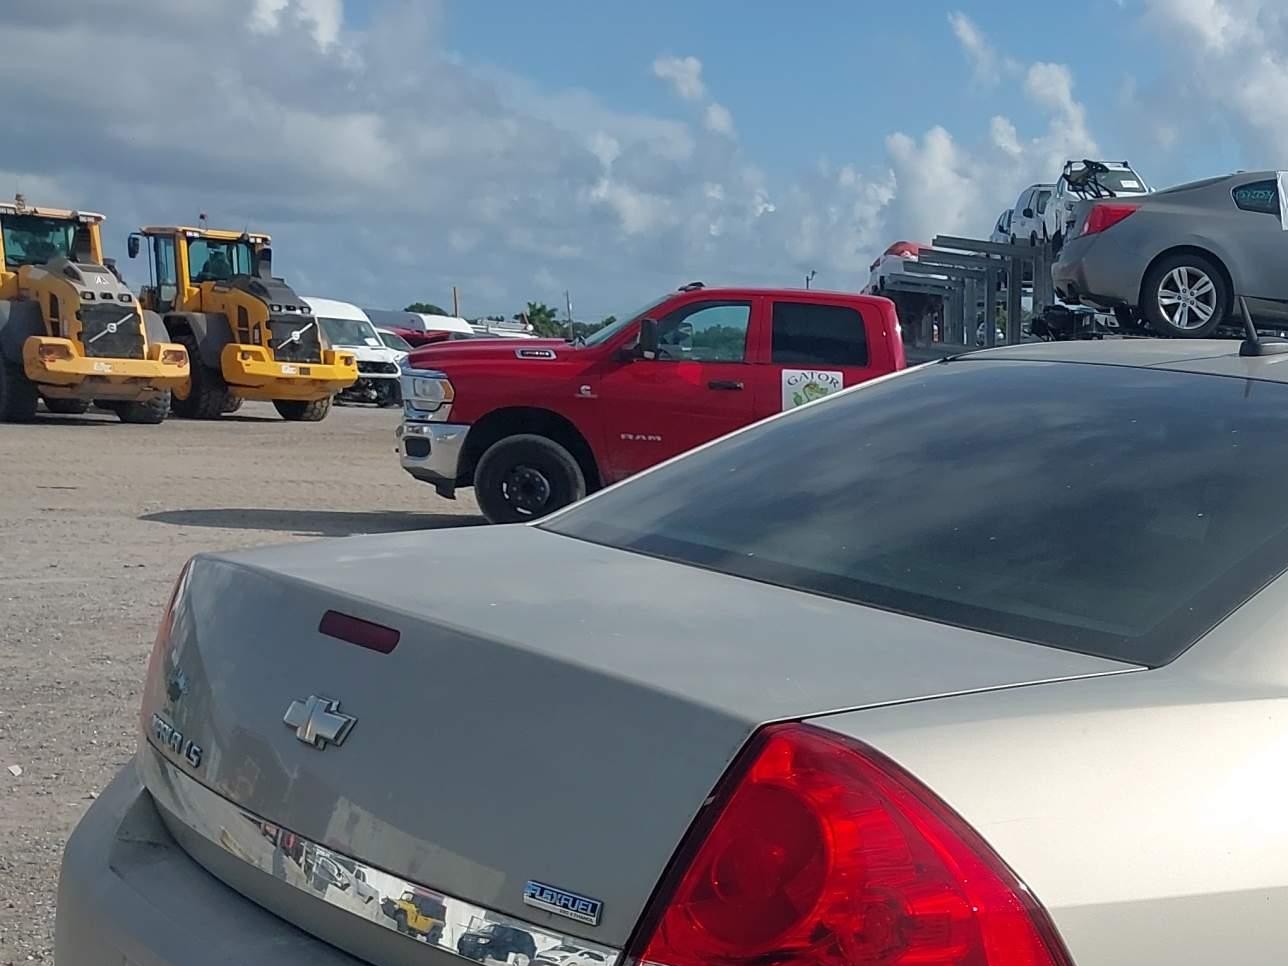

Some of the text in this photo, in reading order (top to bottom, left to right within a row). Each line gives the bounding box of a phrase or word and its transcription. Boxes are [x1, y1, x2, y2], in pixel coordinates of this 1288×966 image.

[787, 371, 839, 388] GATOR
[620, 433, 662, 441] RAM
[184, 740, 202, 768] LS
[527, 883, 595, 916] FLEXFUEL
